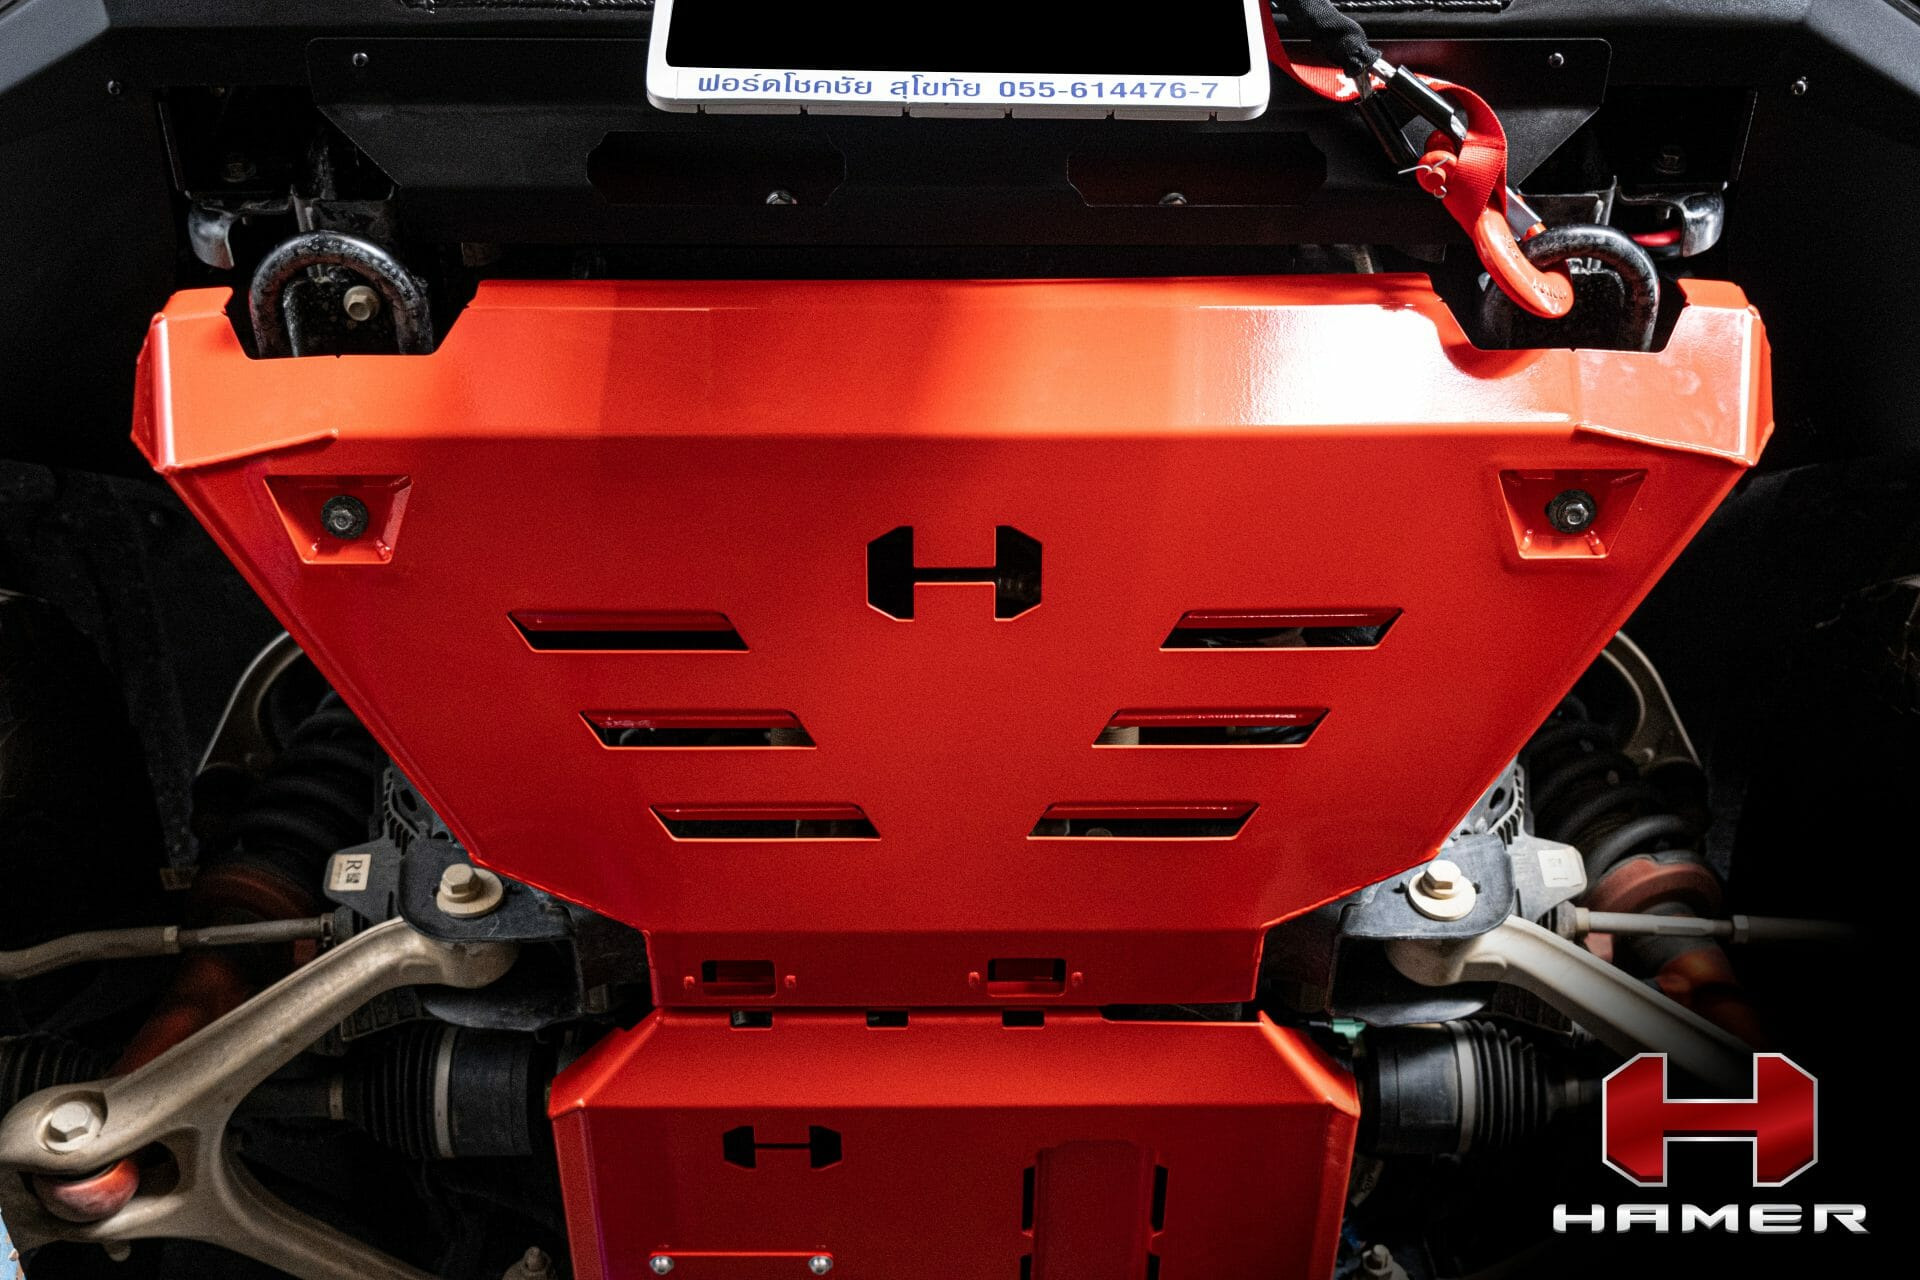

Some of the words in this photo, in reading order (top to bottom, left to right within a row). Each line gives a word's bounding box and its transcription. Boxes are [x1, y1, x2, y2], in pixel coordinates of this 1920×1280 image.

[699, 72, 872, 95] ฟอร์ดโชคชัย
[890, 74, 981, 99] สุโขทัย
[1000, 81, 1218, 99] 055-614476-7
[345, 860, 363, 872] R
